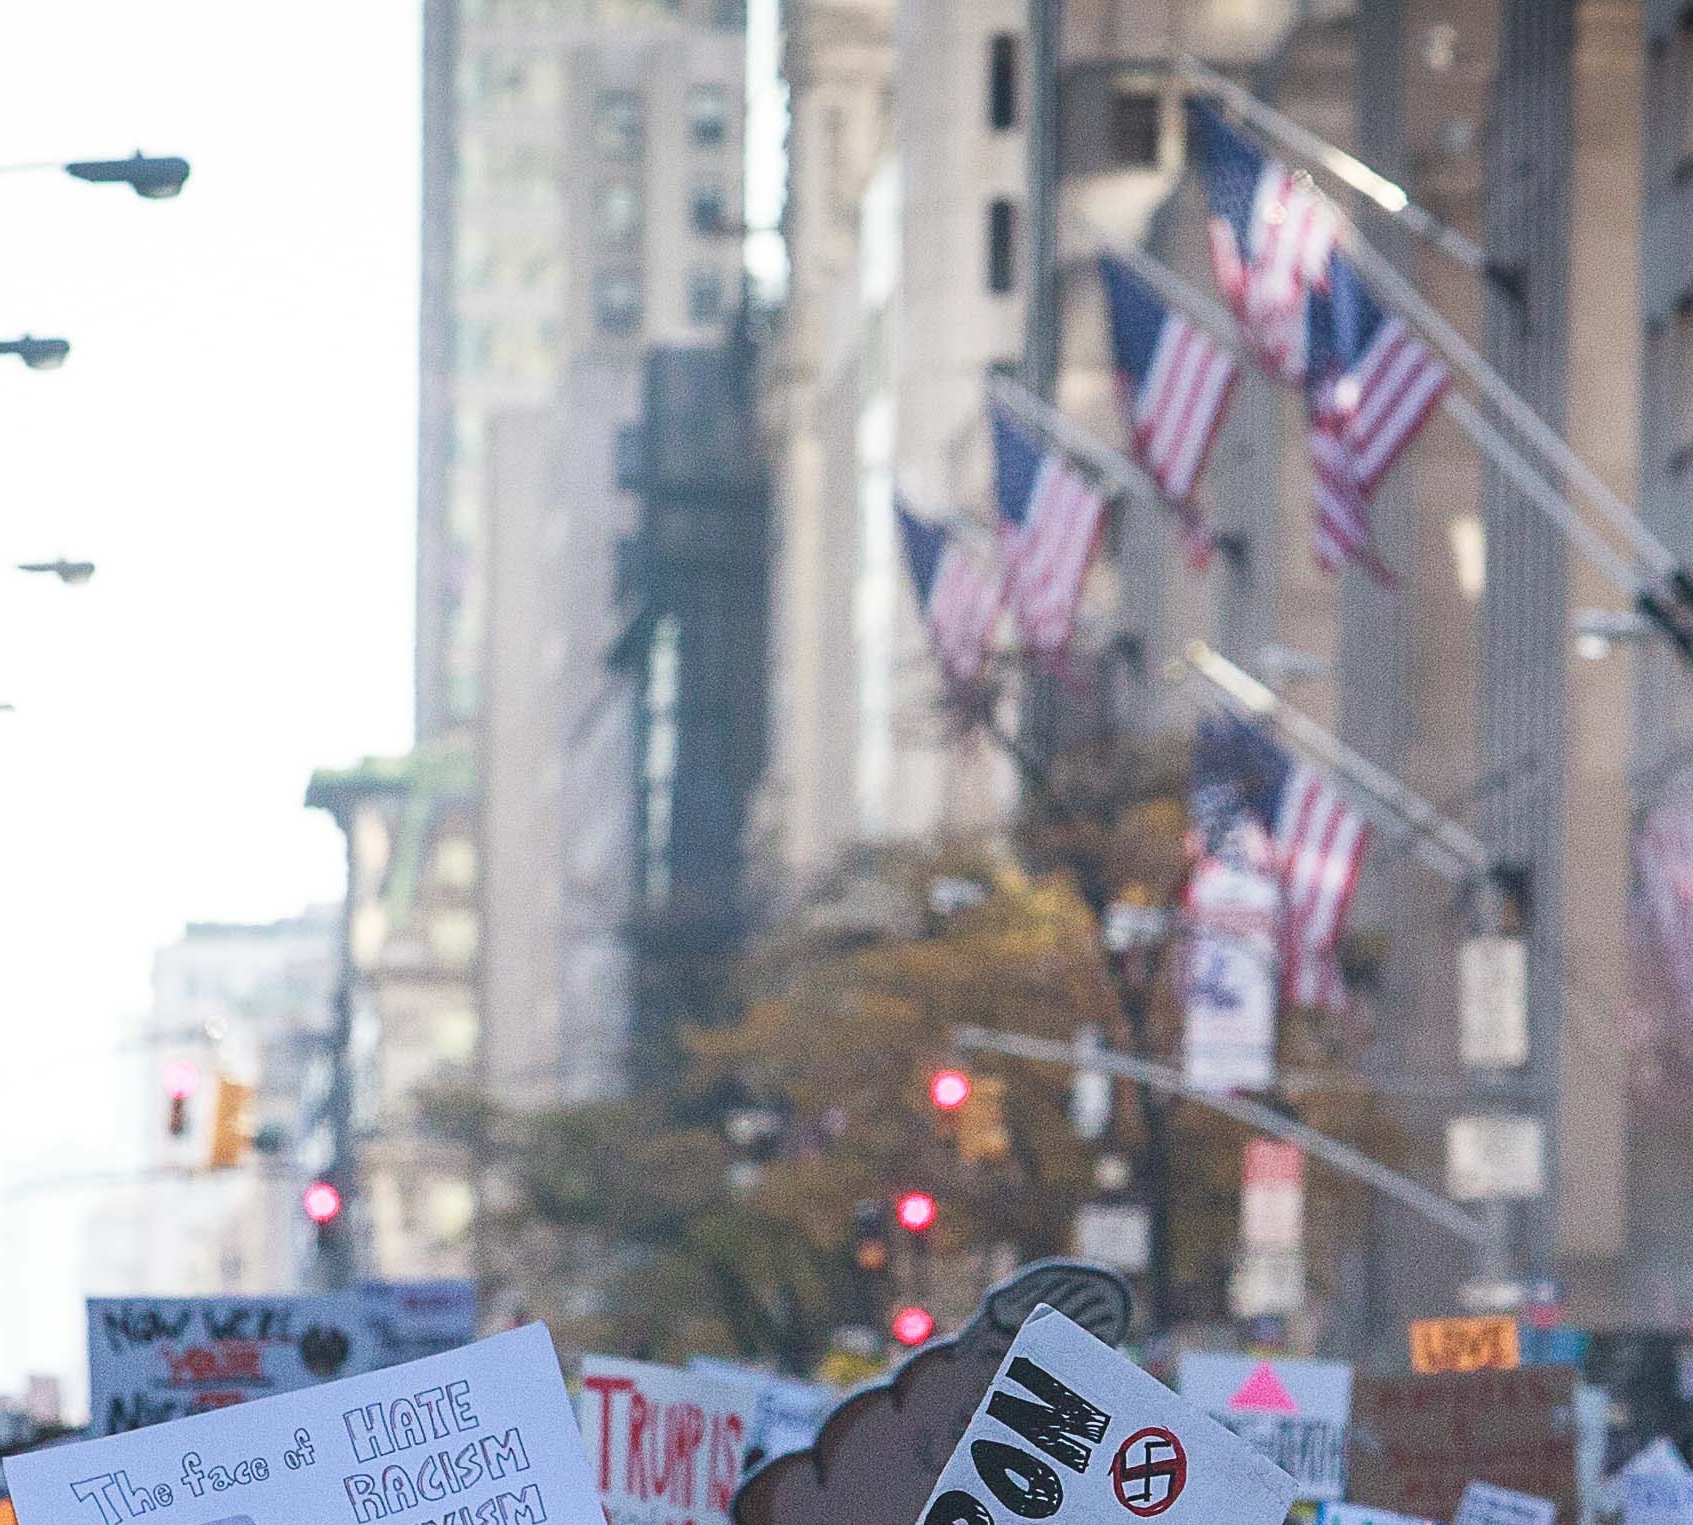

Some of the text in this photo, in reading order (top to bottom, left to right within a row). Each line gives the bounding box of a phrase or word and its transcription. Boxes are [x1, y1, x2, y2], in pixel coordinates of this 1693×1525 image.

[181, 1451, 270, 1498] face
[283, 1427, 316, 1471] of
[342, 1379, 480, 1464] HATE
[343, 1427, 531, 1524] RACISM
